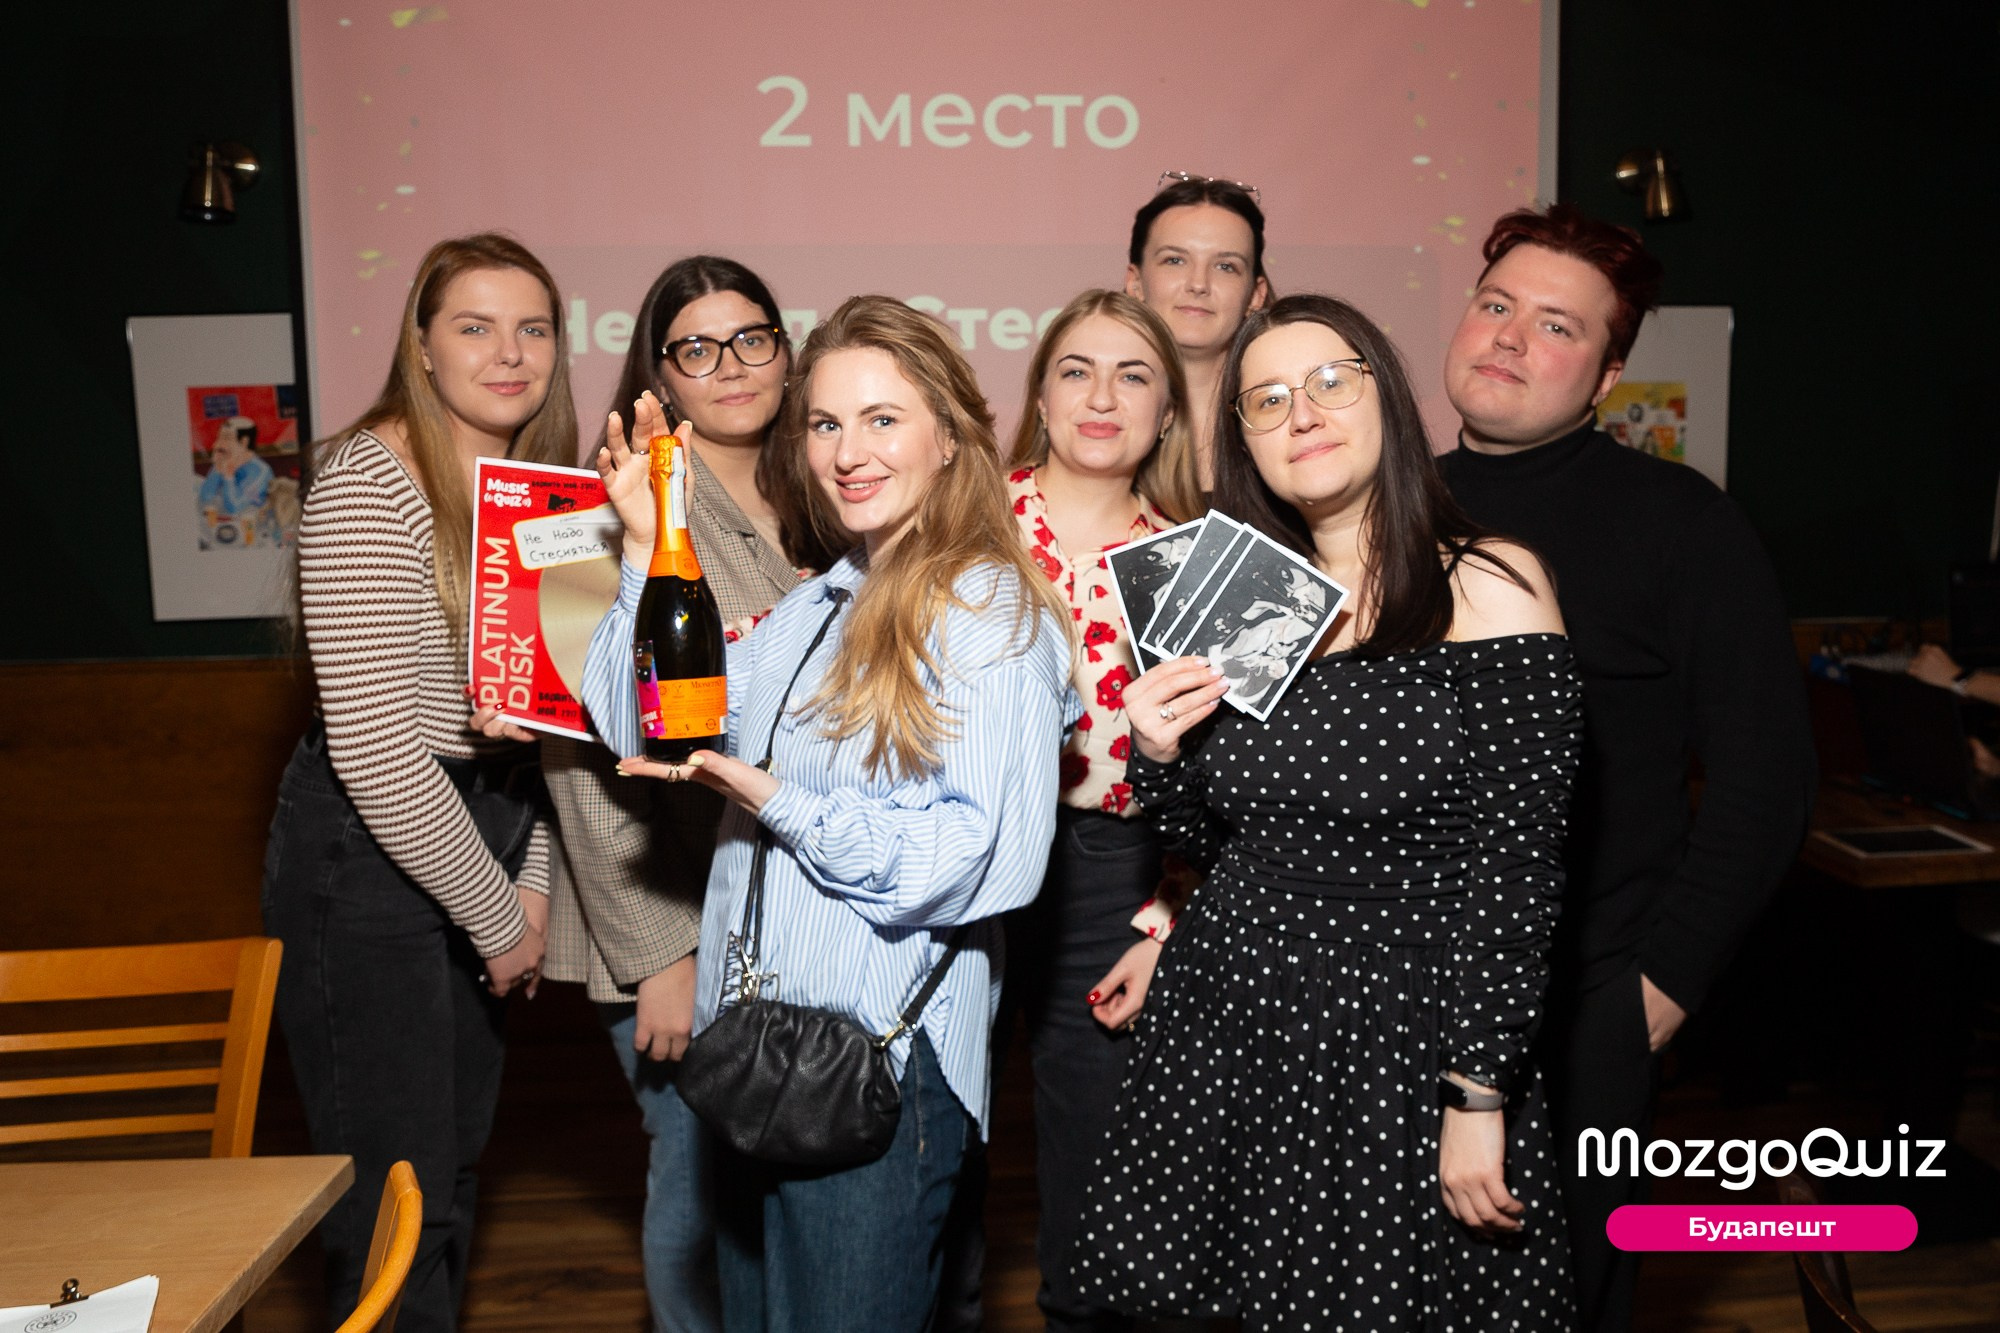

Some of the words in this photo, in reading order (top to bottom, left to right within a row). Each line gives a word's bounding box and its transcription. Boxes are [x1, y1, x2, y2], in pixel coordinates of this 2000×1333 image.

[757, 76, 812, 147] 2
[848, 93, 1140, 149] место
[523, 533, 543, 545] Не
[529, 541, 610, 563] Стесняться
[480, 536, 511, 705] PLATINUM
[507, 632, 536, 711] DISK
